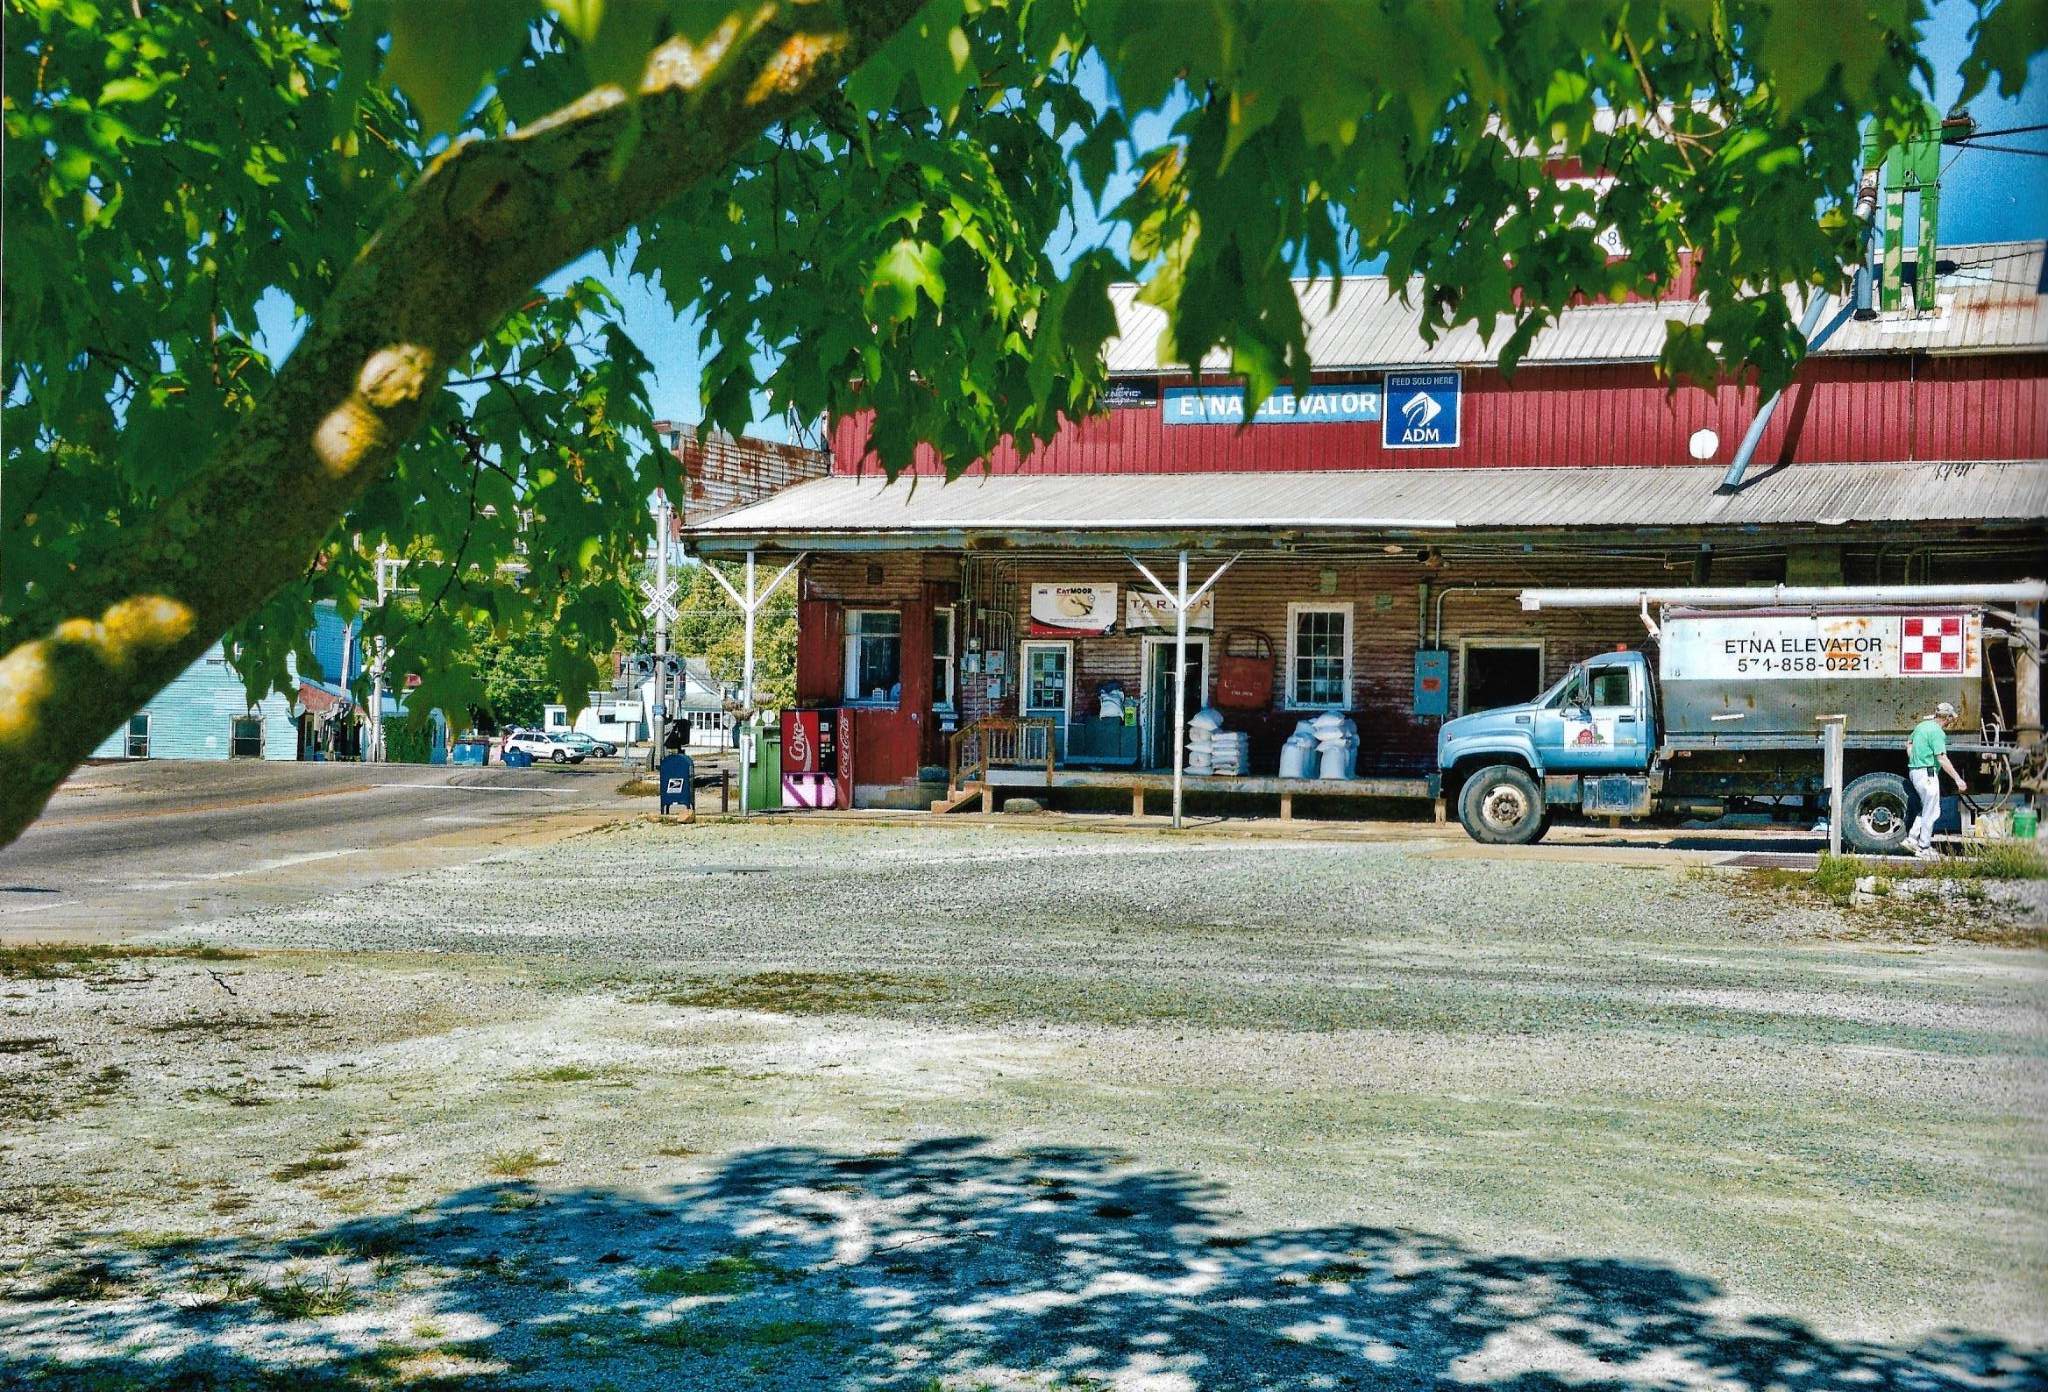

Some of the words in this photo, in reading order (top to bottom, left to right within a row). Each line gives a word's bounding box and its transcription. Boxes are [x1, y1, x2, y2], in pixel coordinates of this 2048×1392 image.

[1391, 377, 1410, 386] FEED
[1412, 377, 1432, 385] SOLD
[1433, 376, 1454, 385] HERE
[1180, 395, 1243, 416] ETNA
[1401, 428, 1440, 443] ADM
[1131, 600, 1210, 609] TARR
[1725, 639, 1776, 654] ETNA
[1781, 637, 1881, 653] ELEVATOR
[789, 722, 805, 761] Coke
